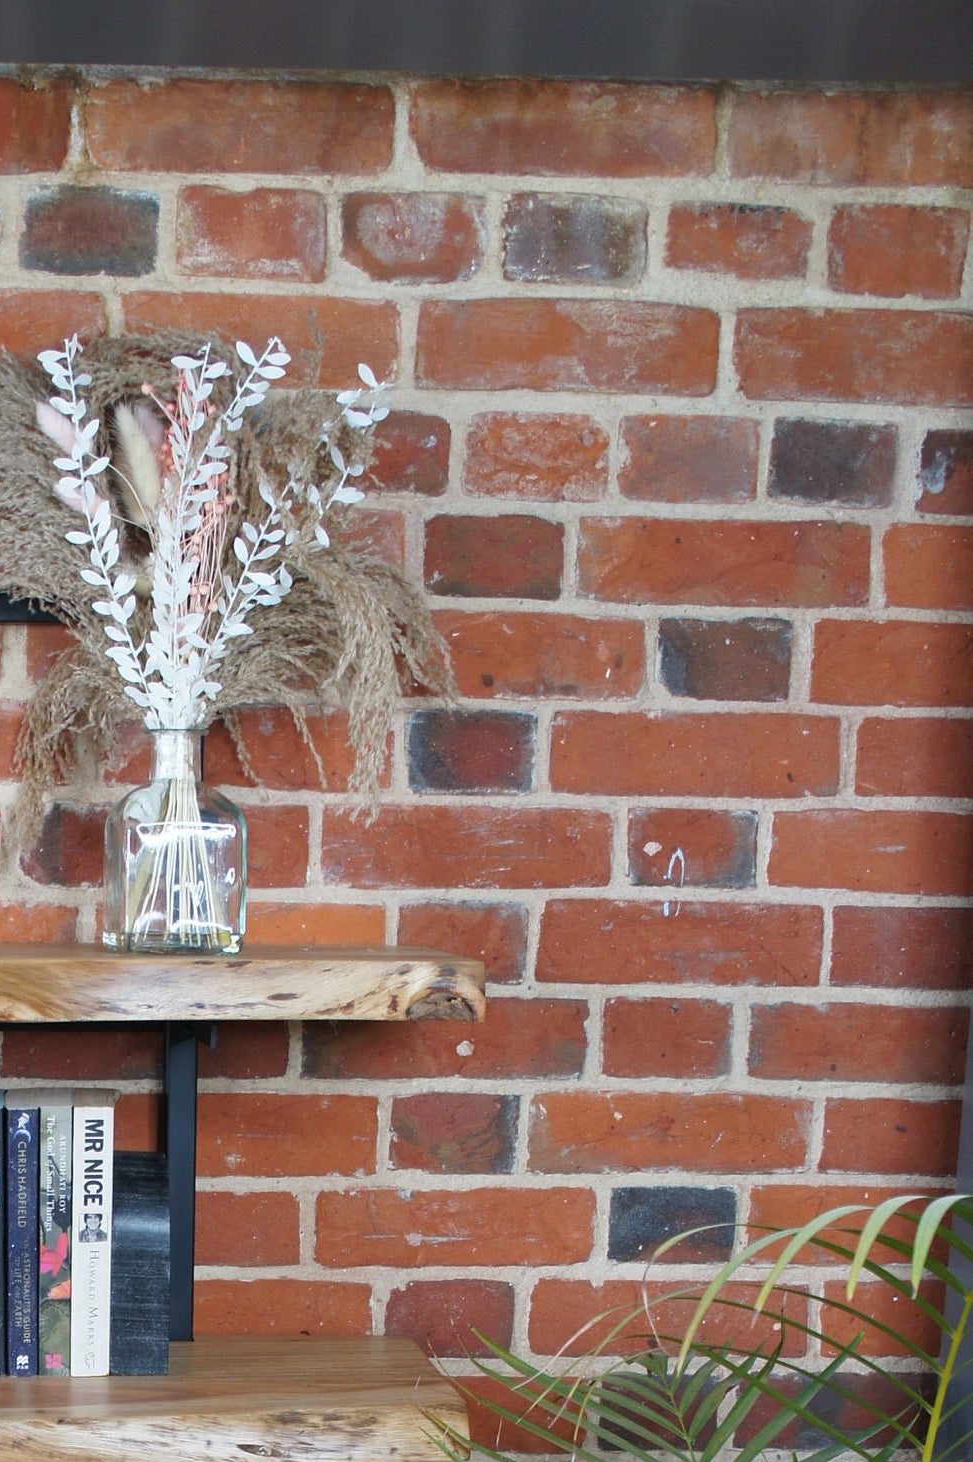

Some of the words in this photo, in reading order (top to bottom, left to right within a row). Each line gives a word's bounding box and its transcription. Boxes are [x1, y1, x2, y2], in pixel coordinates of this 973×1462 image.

[46, 1115, 56, 1134] The
[84, 1119, 104, 1152] MR
[17, 1141, 27, 1174] CHRIS
[46, 1136, 56, 1157] God
[59, 1134, 67, 1192] ARUNDHATI
[46, 1170, 56, 1197] Small
[83, 1159, 104, 1206] NICE
[17, 1176, 27, 1228] HADFIELD
[44, 1199, 56, 1232] Things
[59, 1194, 67, 1214] ROY
[14, 1267, 22, 1284] LIFE
[22, 1253, 31, 1314] ASTRONAUT'S
[15, 1298, 23, 1328] EARTH
[22, 1316, 31, 1344] GUIDE
